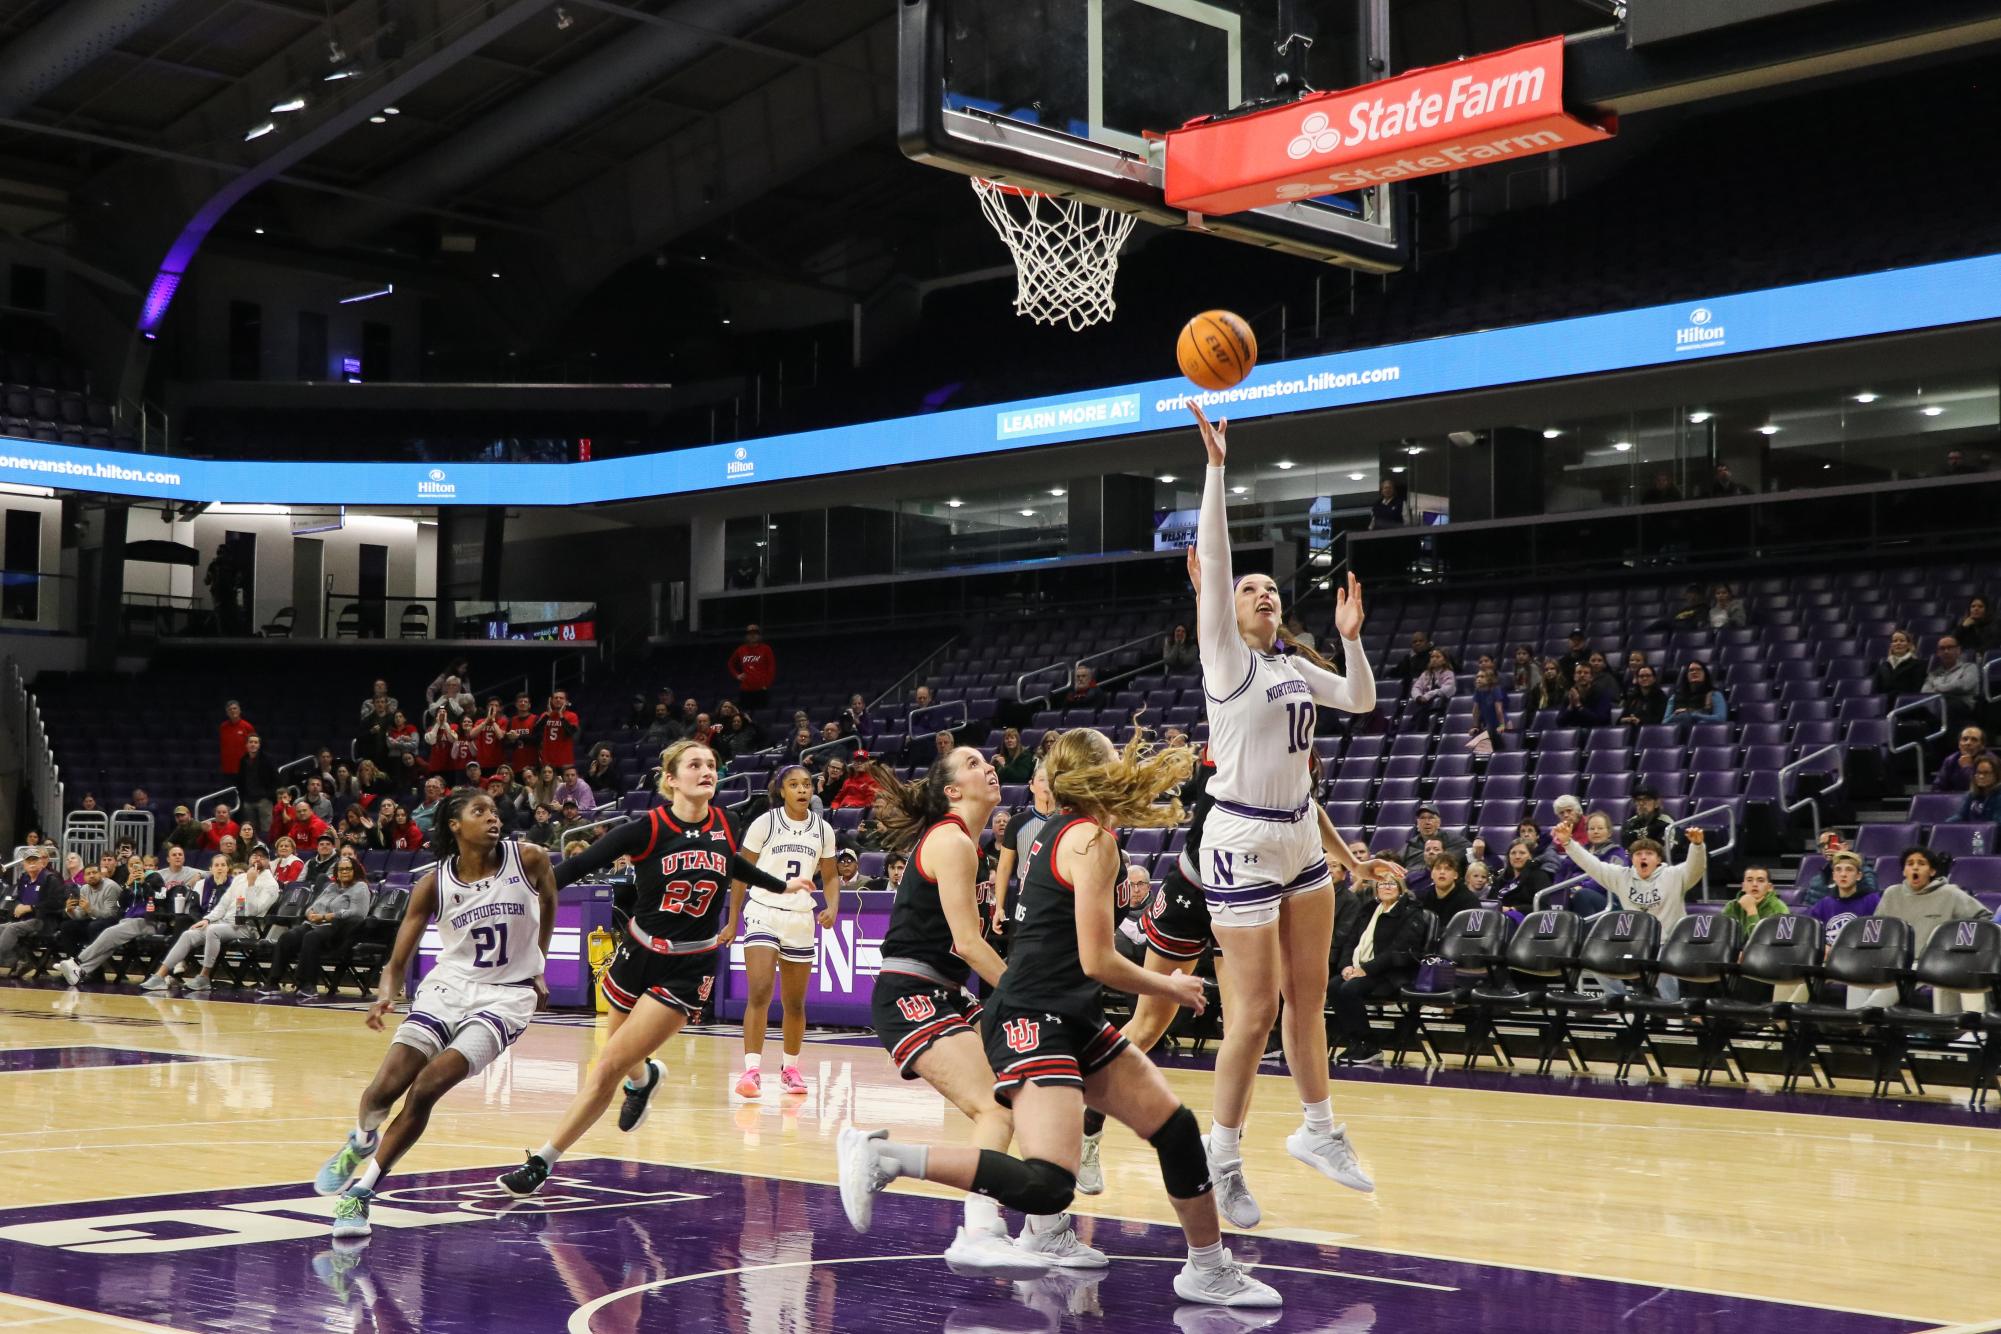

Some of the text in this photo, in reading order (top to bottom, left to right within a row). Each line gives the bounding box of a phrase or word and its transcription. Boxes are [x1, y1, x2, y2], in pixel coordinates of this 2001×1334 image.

[1676, 326, 1725, 345] Hilton
[1003, 366, 1400, 433] LEARN MORE AT: orringtonevanston.hilton.com
[727, 460, 754, 474] Hilton
[418, 481, 456, 493] Hilton
[485, 732, 494, 745] 5
[549, 727, 558, 741] 5
[1286, 701, 1315, 753] 10
[460, 746, 468, 759] 5
[771, 843, 817, 859] NORTHWESTERN
[661, 850, 727, 877] UTAH
[785, 860, 801, 881] 2
[1213, 850, 1234, 886] N
[658, 880, 719, 918] 23
[1628, 886, 1662, 904] YALE
[450, 902, 526, 931] NORTHWESTERN
[1466, 911, 1485, 932] N
[1538, 912, 1558, 934] N
[1615, 913, 1635, 936] N
[1693, 915, 1713, 938] N
[1776, 916, 1797, 940] N
[1862, 919, 1883, 943] N
[1955, 922, 1978, 946] N
[470, 922, 509, 969] 21
[820, 919, 854, 993] N
